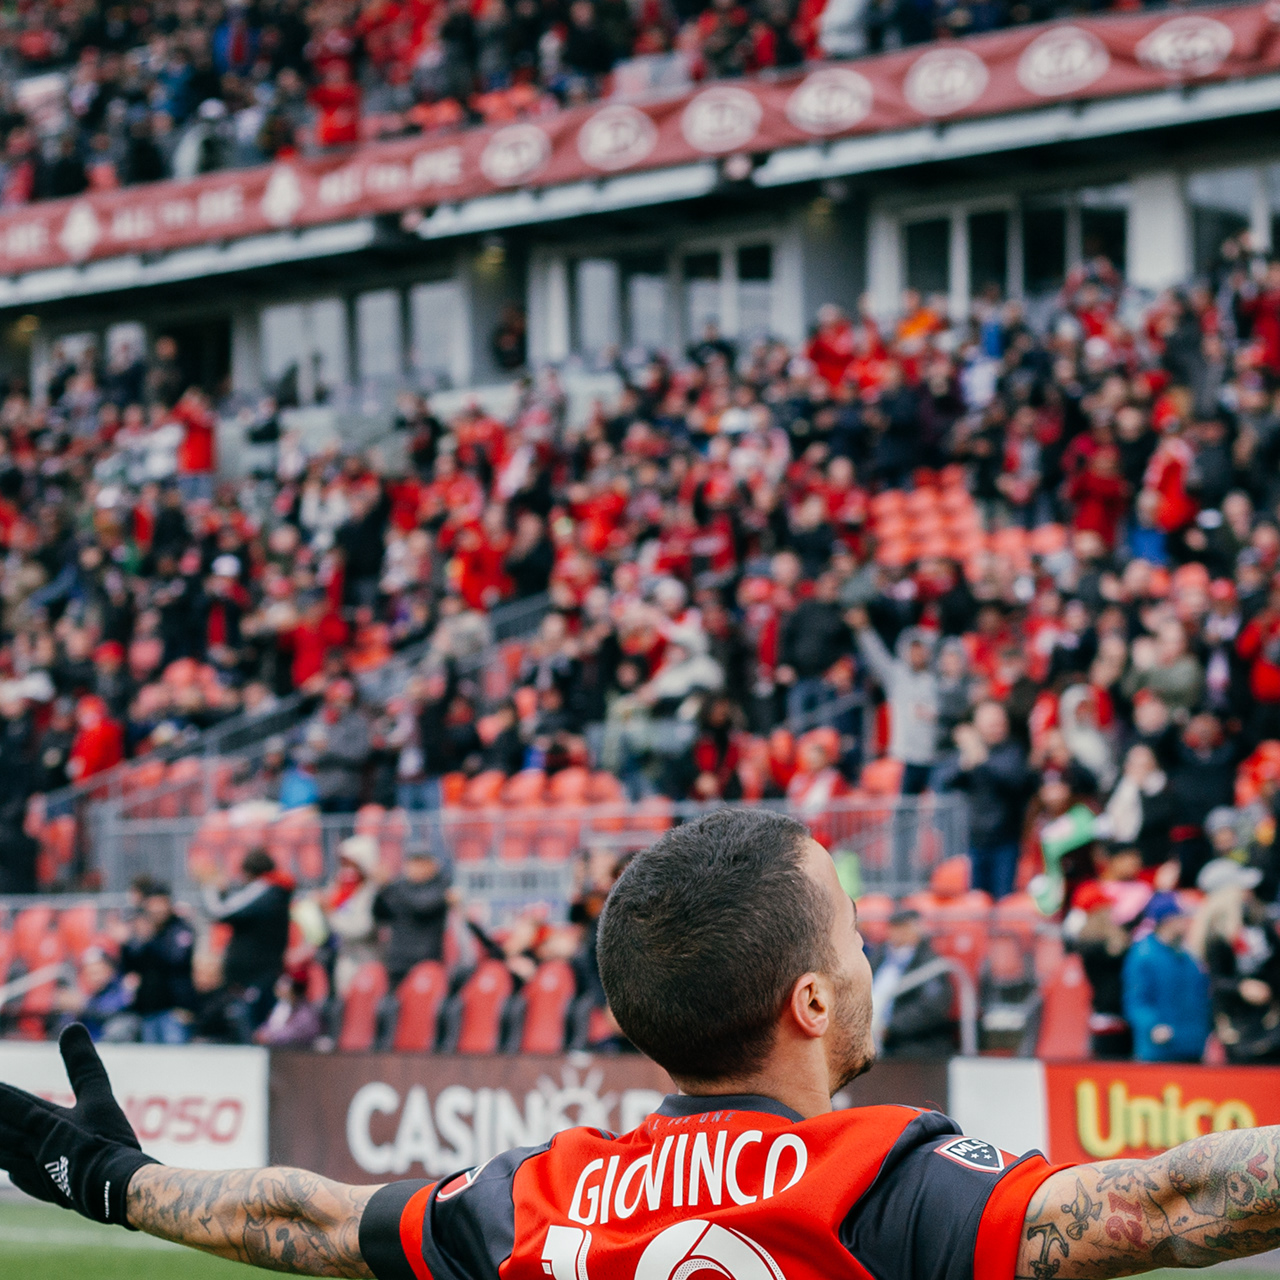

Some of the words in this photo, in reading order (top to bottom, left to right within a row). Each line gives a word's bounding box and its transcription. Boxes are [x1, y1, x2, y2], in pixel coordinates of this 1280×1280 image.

[699, 1111, 736, 1123] ONE
[1077, 1080, 1256, 1158] Unico
[950, 1139, 988, 1157] MLS
[568, 1130, 808, 1226] GIOVINCO
